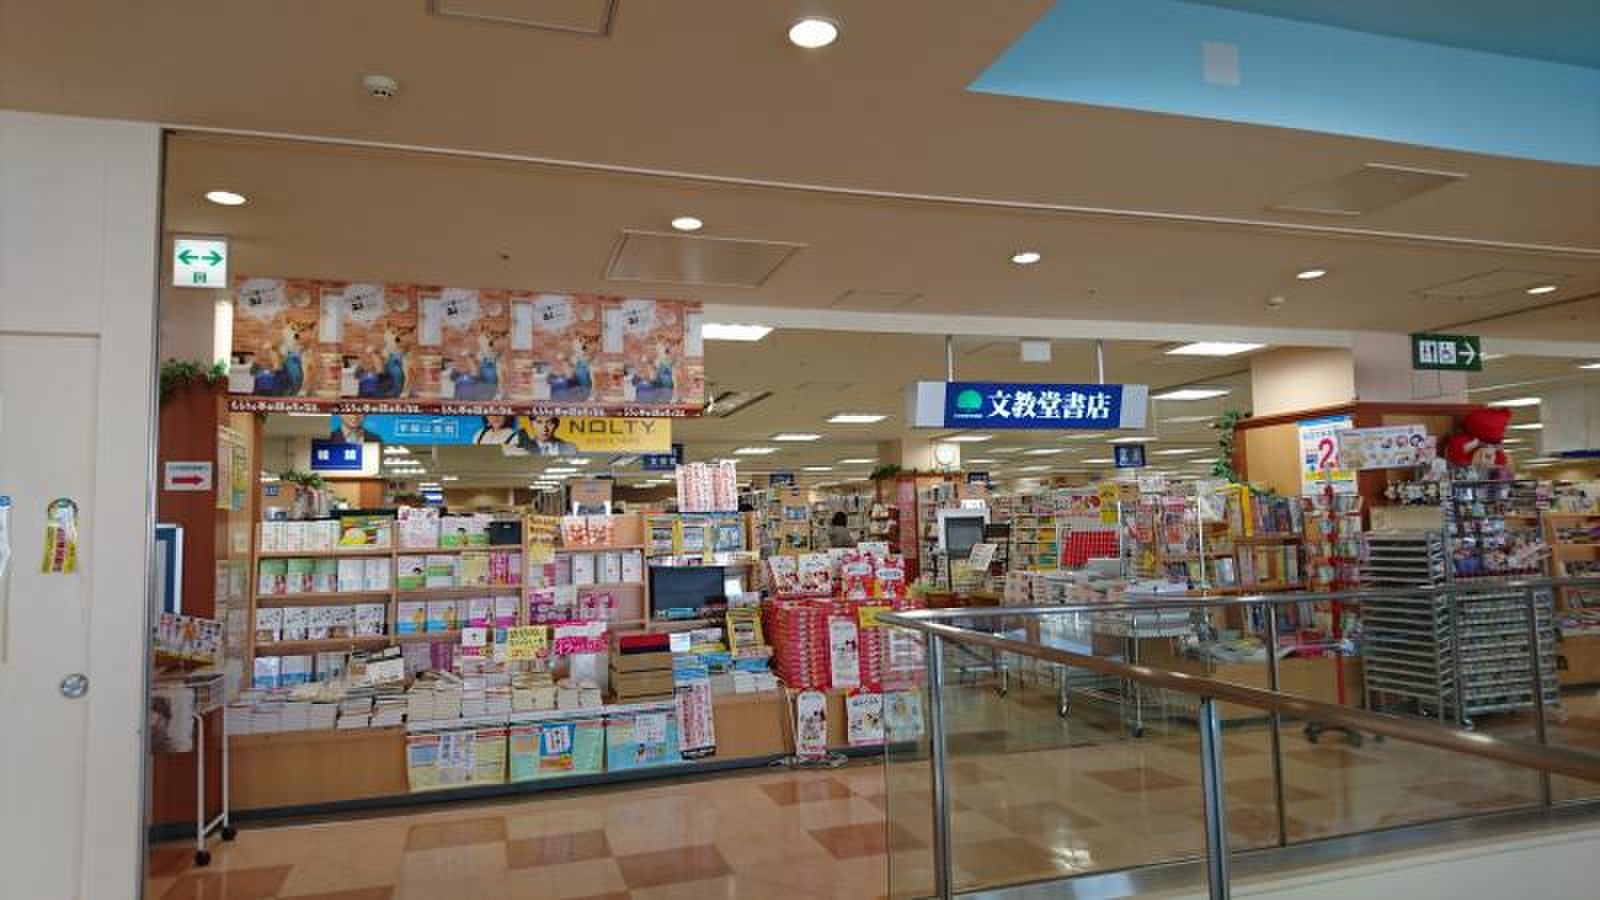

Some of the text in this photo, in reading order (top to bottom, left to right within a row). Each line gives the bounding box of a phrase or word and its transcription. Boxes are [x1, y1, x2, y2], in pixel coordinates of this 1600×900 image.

[988, 390, 1112, 419] 文教堂書店
[570, 420, 655, 434] NOLTY
